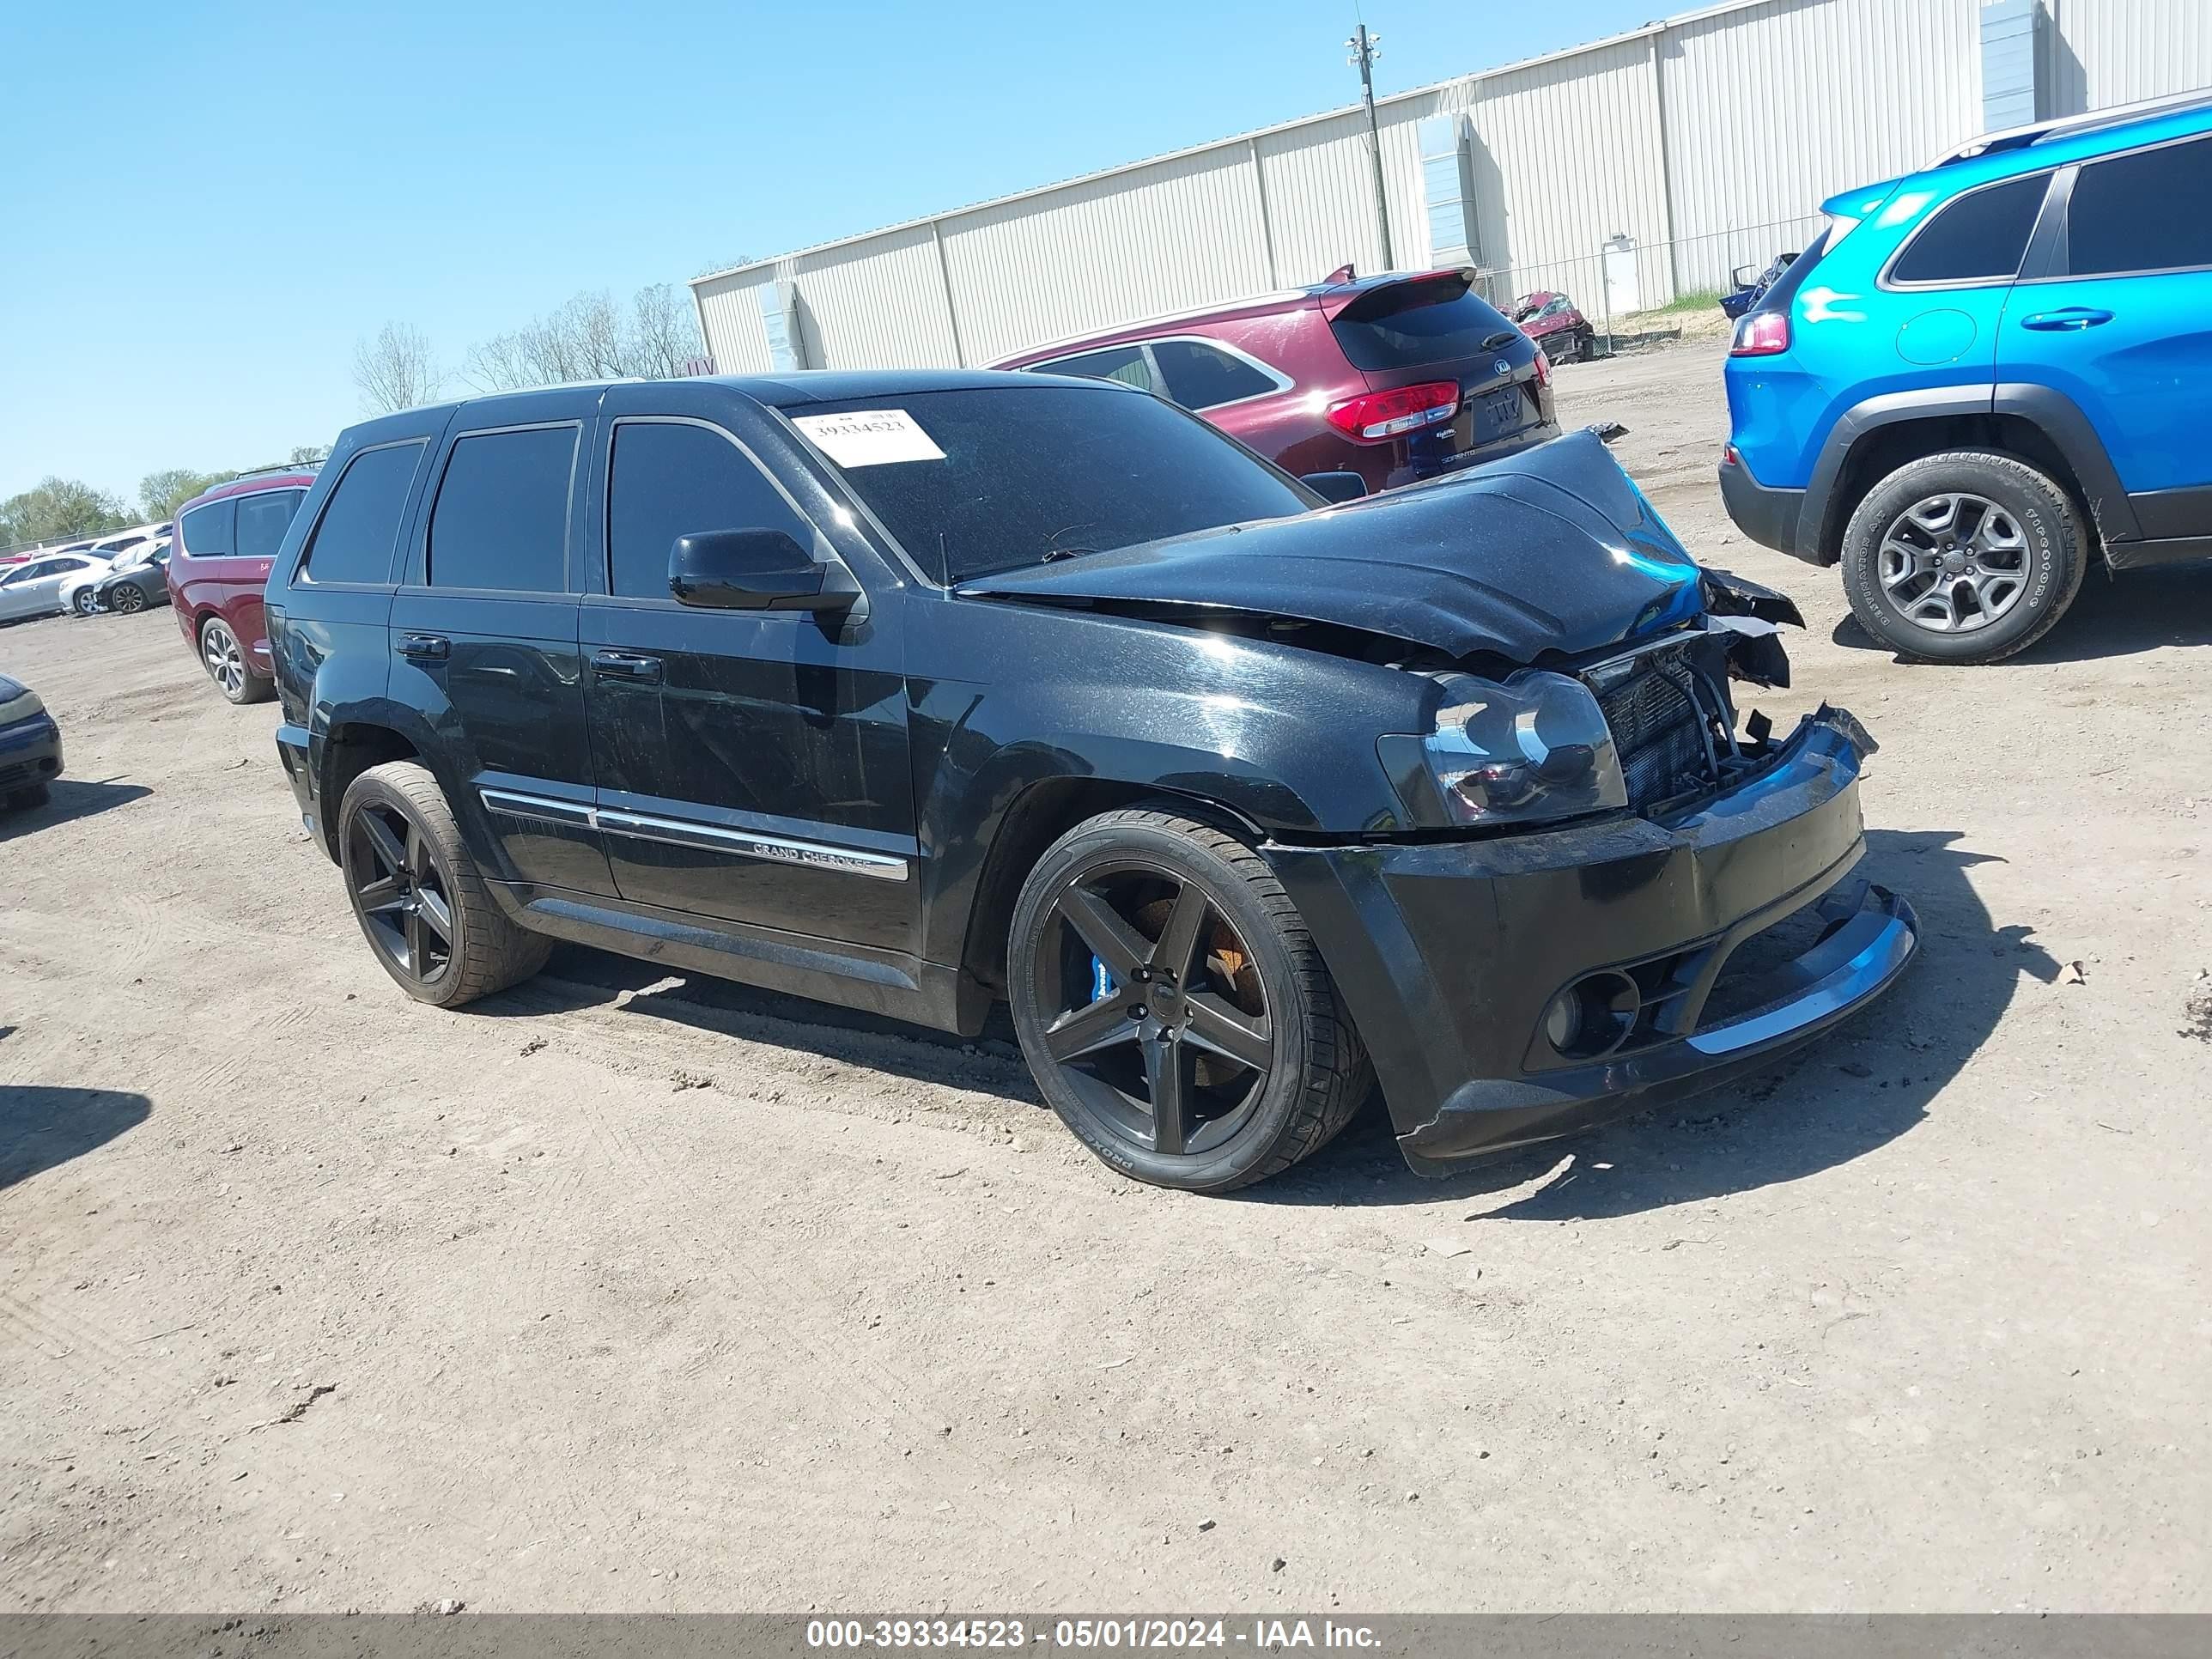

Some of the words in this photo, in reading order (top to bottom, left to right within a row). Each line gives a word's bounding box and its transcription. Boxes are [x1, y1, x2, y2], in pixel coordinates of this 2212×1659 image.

[1497, 362, 1511, 374] KIA
[816, 422, 905, 436] 39334523
[1441, 449, 1475, 464] SORENTO
[2026, 508, 2051, 608] Firestone
[1858, 536, 1891, 626] DESTINATION
[753, 843, 799, 859] GRAND
[801, 851, 872, 870] CHEROKEE
[1075, 1123, 1133, 1170] PROXES
